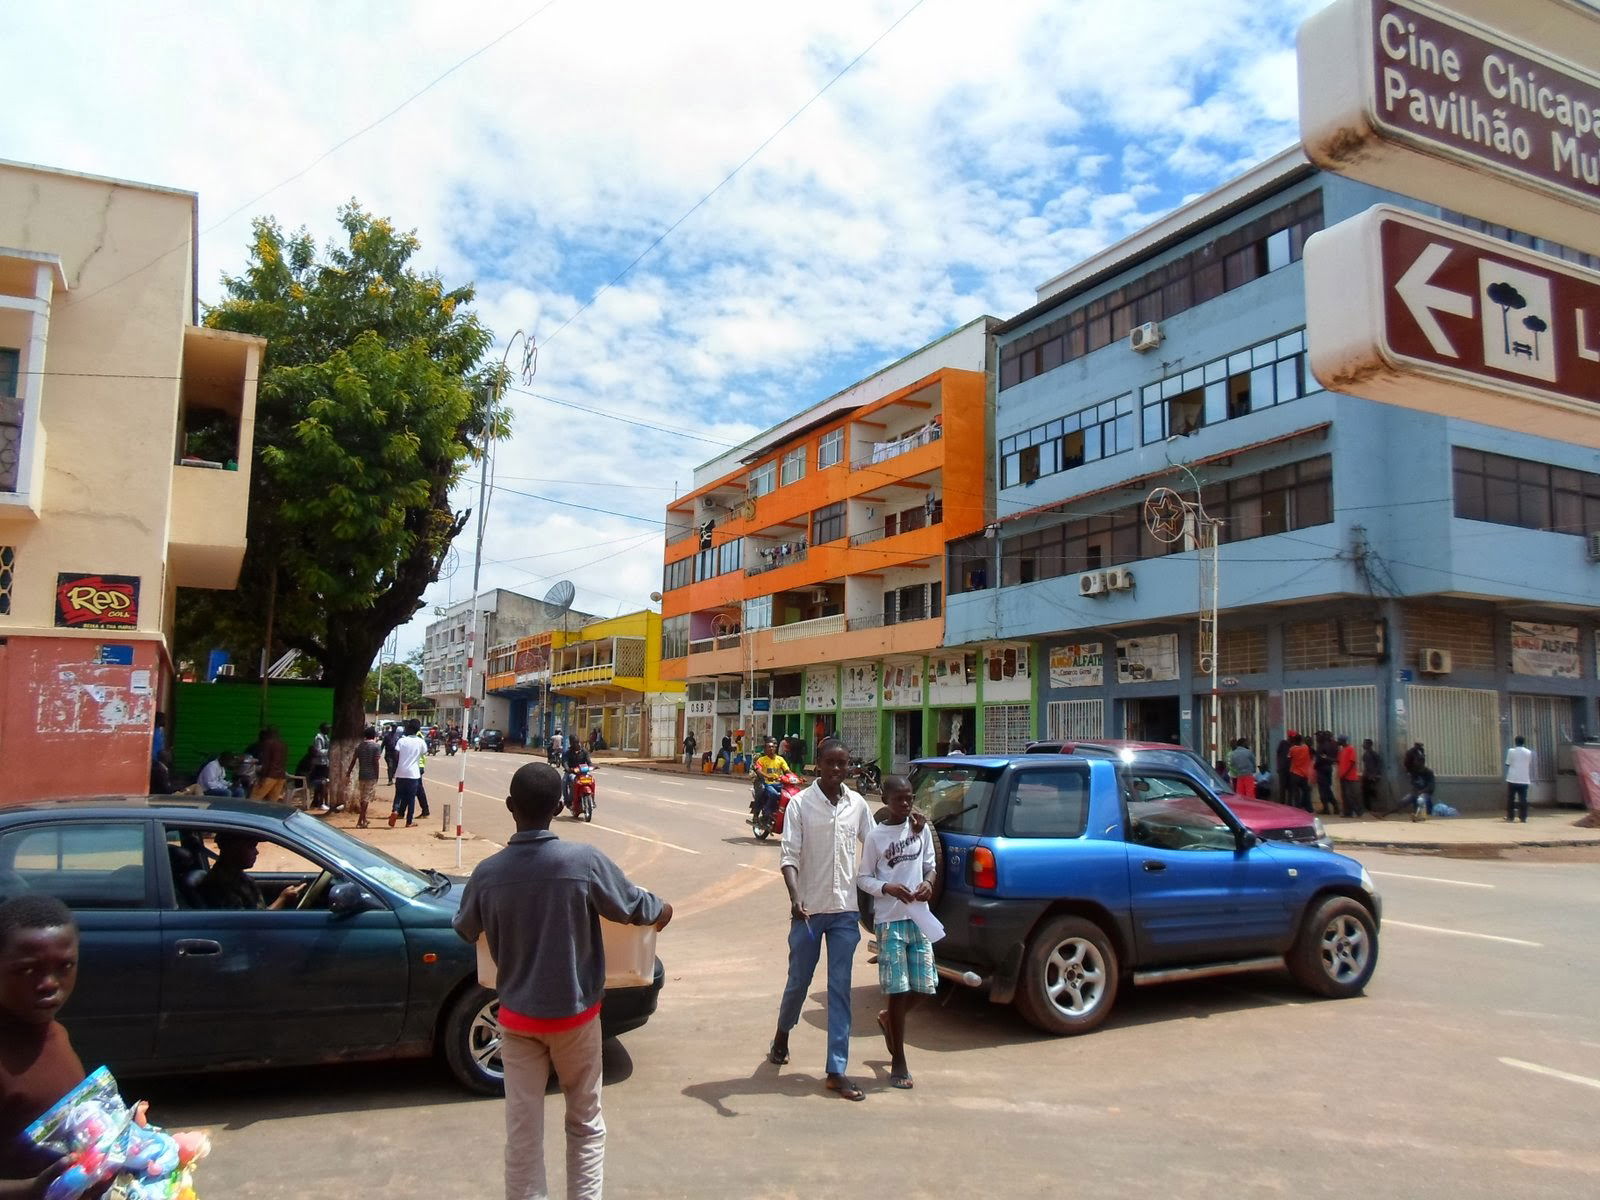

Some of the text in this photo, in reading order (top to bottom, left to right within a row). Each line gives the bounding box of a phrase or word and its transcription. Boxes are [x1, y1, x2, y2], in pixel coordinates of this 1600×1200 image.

[1379, 13, 1461, 82] Cine
[1383, 68, 1600, 186] Pavilhão Mu
